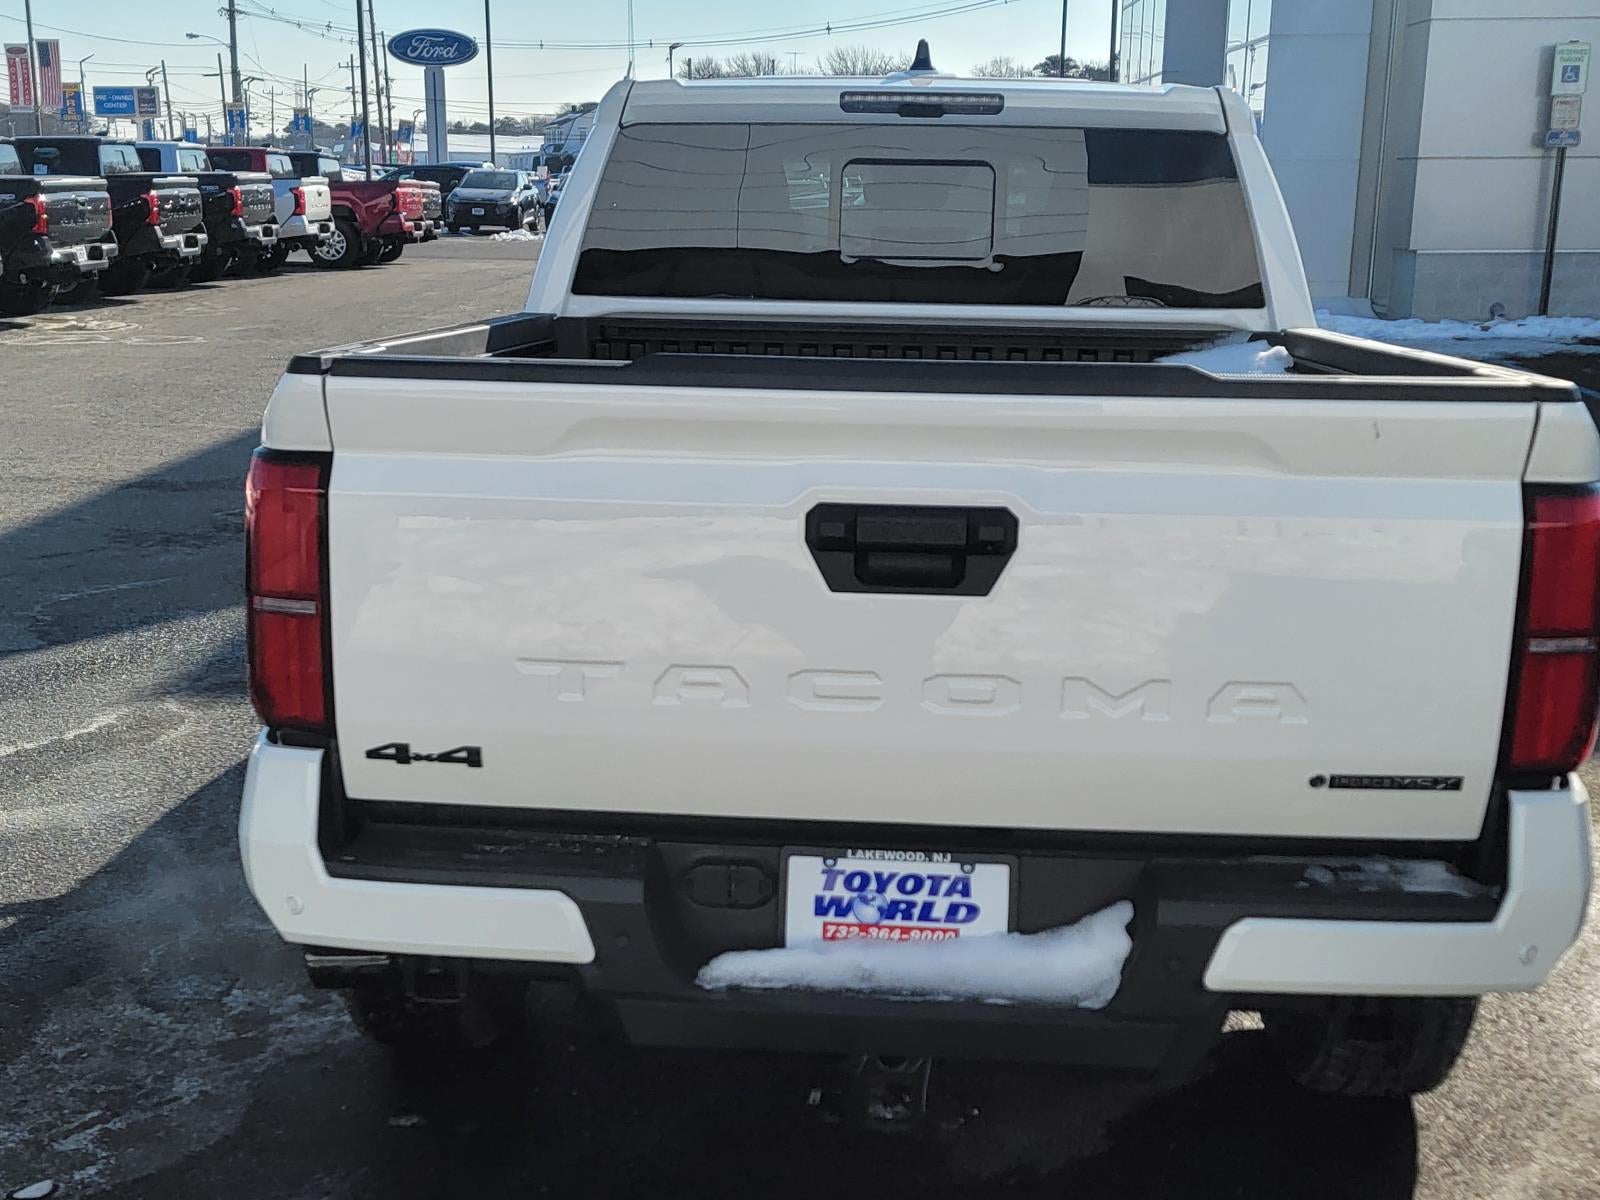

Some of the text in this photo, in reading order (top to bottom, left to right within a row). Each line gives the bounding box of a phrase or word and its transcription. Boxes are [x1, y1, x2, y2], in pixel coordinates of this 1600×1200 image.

[408, 35, 458, 58] Ford
[515, 657, 1309, 725] TACOMA
[820, 868, 973, 898] TOYOTA
